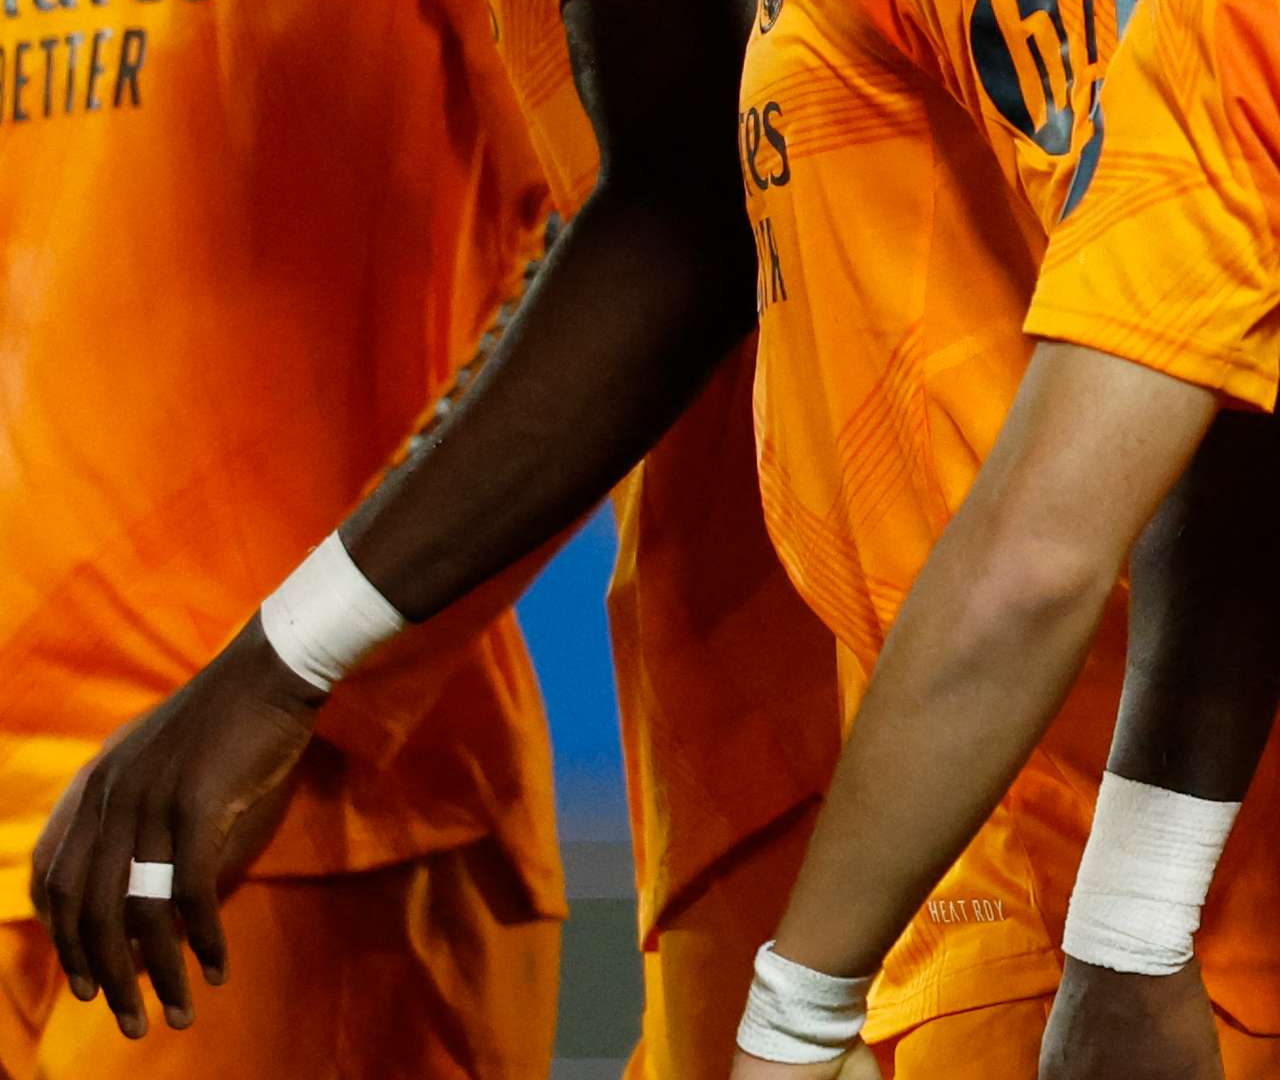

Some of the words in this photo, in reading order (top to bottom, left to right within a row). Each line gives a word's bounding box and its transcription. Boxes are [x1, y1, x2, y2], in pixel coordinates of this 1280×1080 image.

[0, 28, 147, 125] ETTER
[928, 899, 969, 923] HEAT
[971, 899, 1006, 921] RDY
